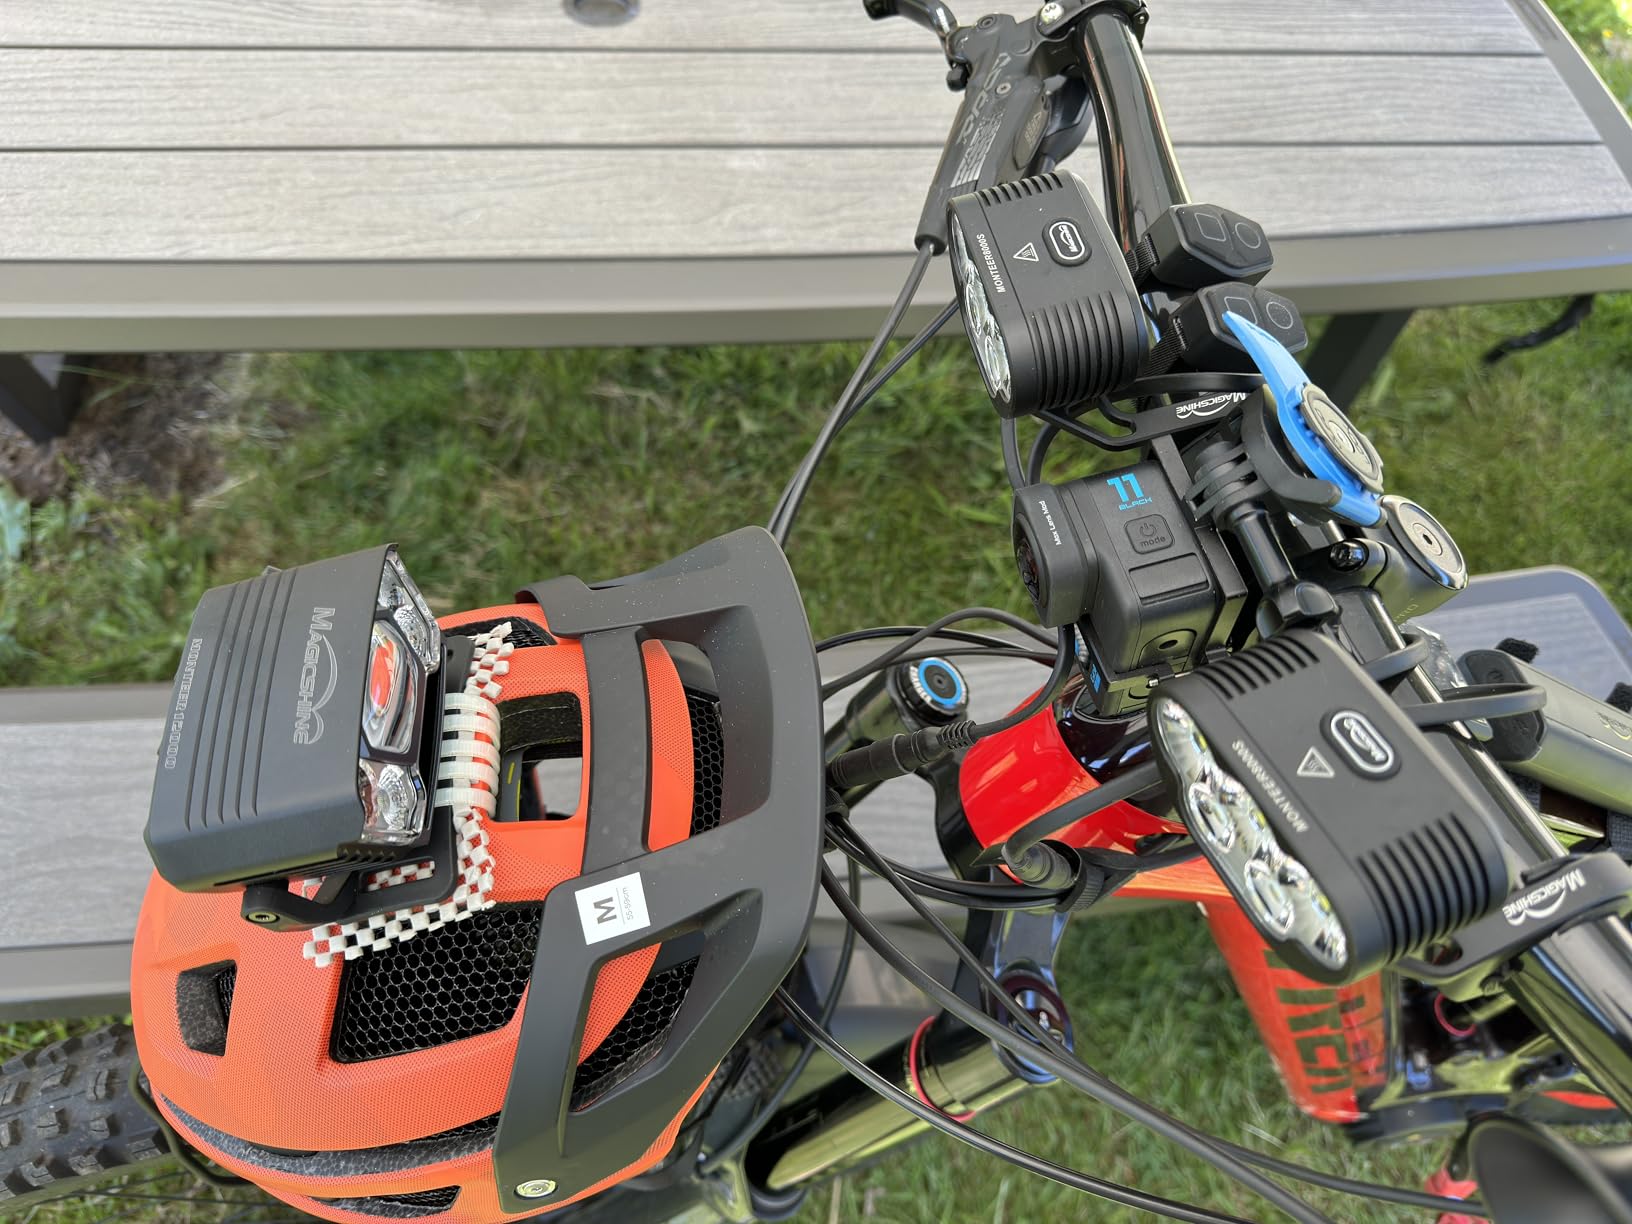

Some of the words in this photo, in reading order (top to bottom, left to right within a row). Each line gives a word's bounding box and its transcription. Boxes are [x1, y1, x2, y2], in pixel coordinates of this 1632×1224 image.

[976, 233, 1006, 294] MONTEER8000S
[1176, 392, 1247, 417] MAGICSHINE
[1106, 473, 1145, 503] 11
[1038, 500, 1050, 515] Mod
[1118, 497, 1153, 511] BLACK
[1140, 535, 1166, 548] mode
[293, 607, 338, 745] MAGICSHINE
[593, 896, 618, 925] M
[1502, 868, 1586, 925] MAGICSHINE
